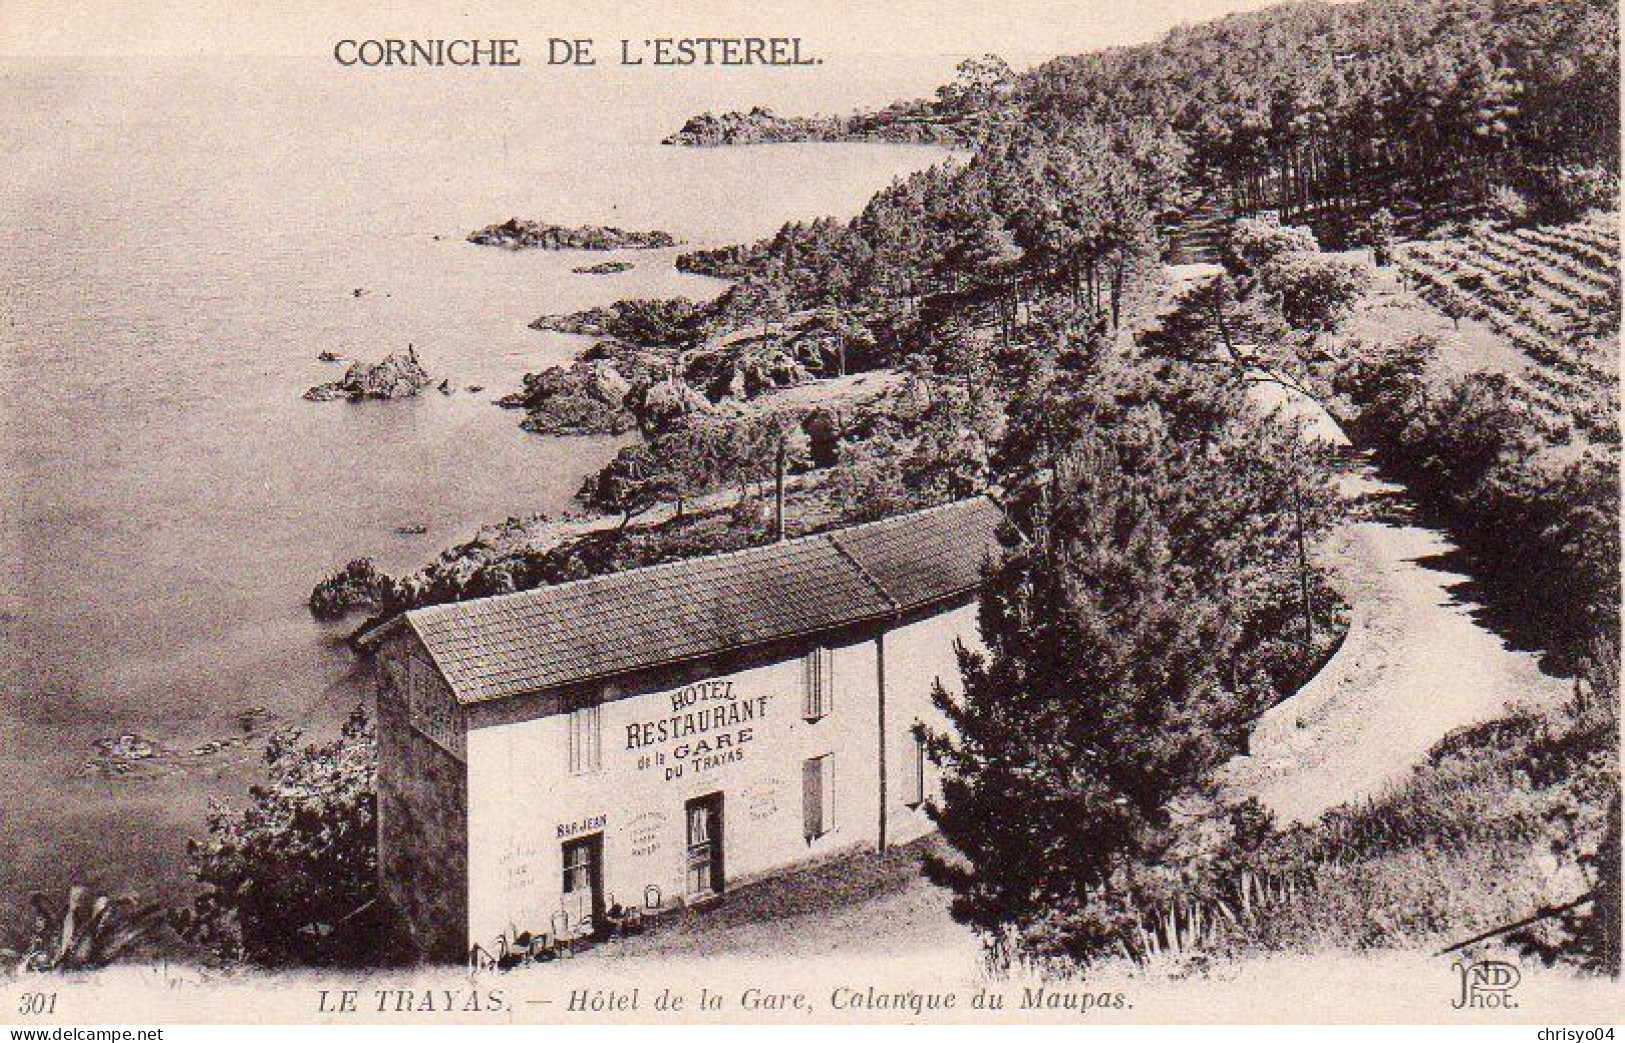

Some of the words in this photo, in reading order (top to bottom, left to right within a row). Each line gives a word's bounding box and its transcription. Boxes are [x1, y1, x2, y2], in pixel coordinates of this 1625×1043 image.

[670, 681, 737, 713] HOTEL
[625, 695, 773, 751] RESTAURANT
[673, 727, 753, 760] GARE
[665, 763, 683, 781] DU
[692, 747, 744, 773] TRAYAS
